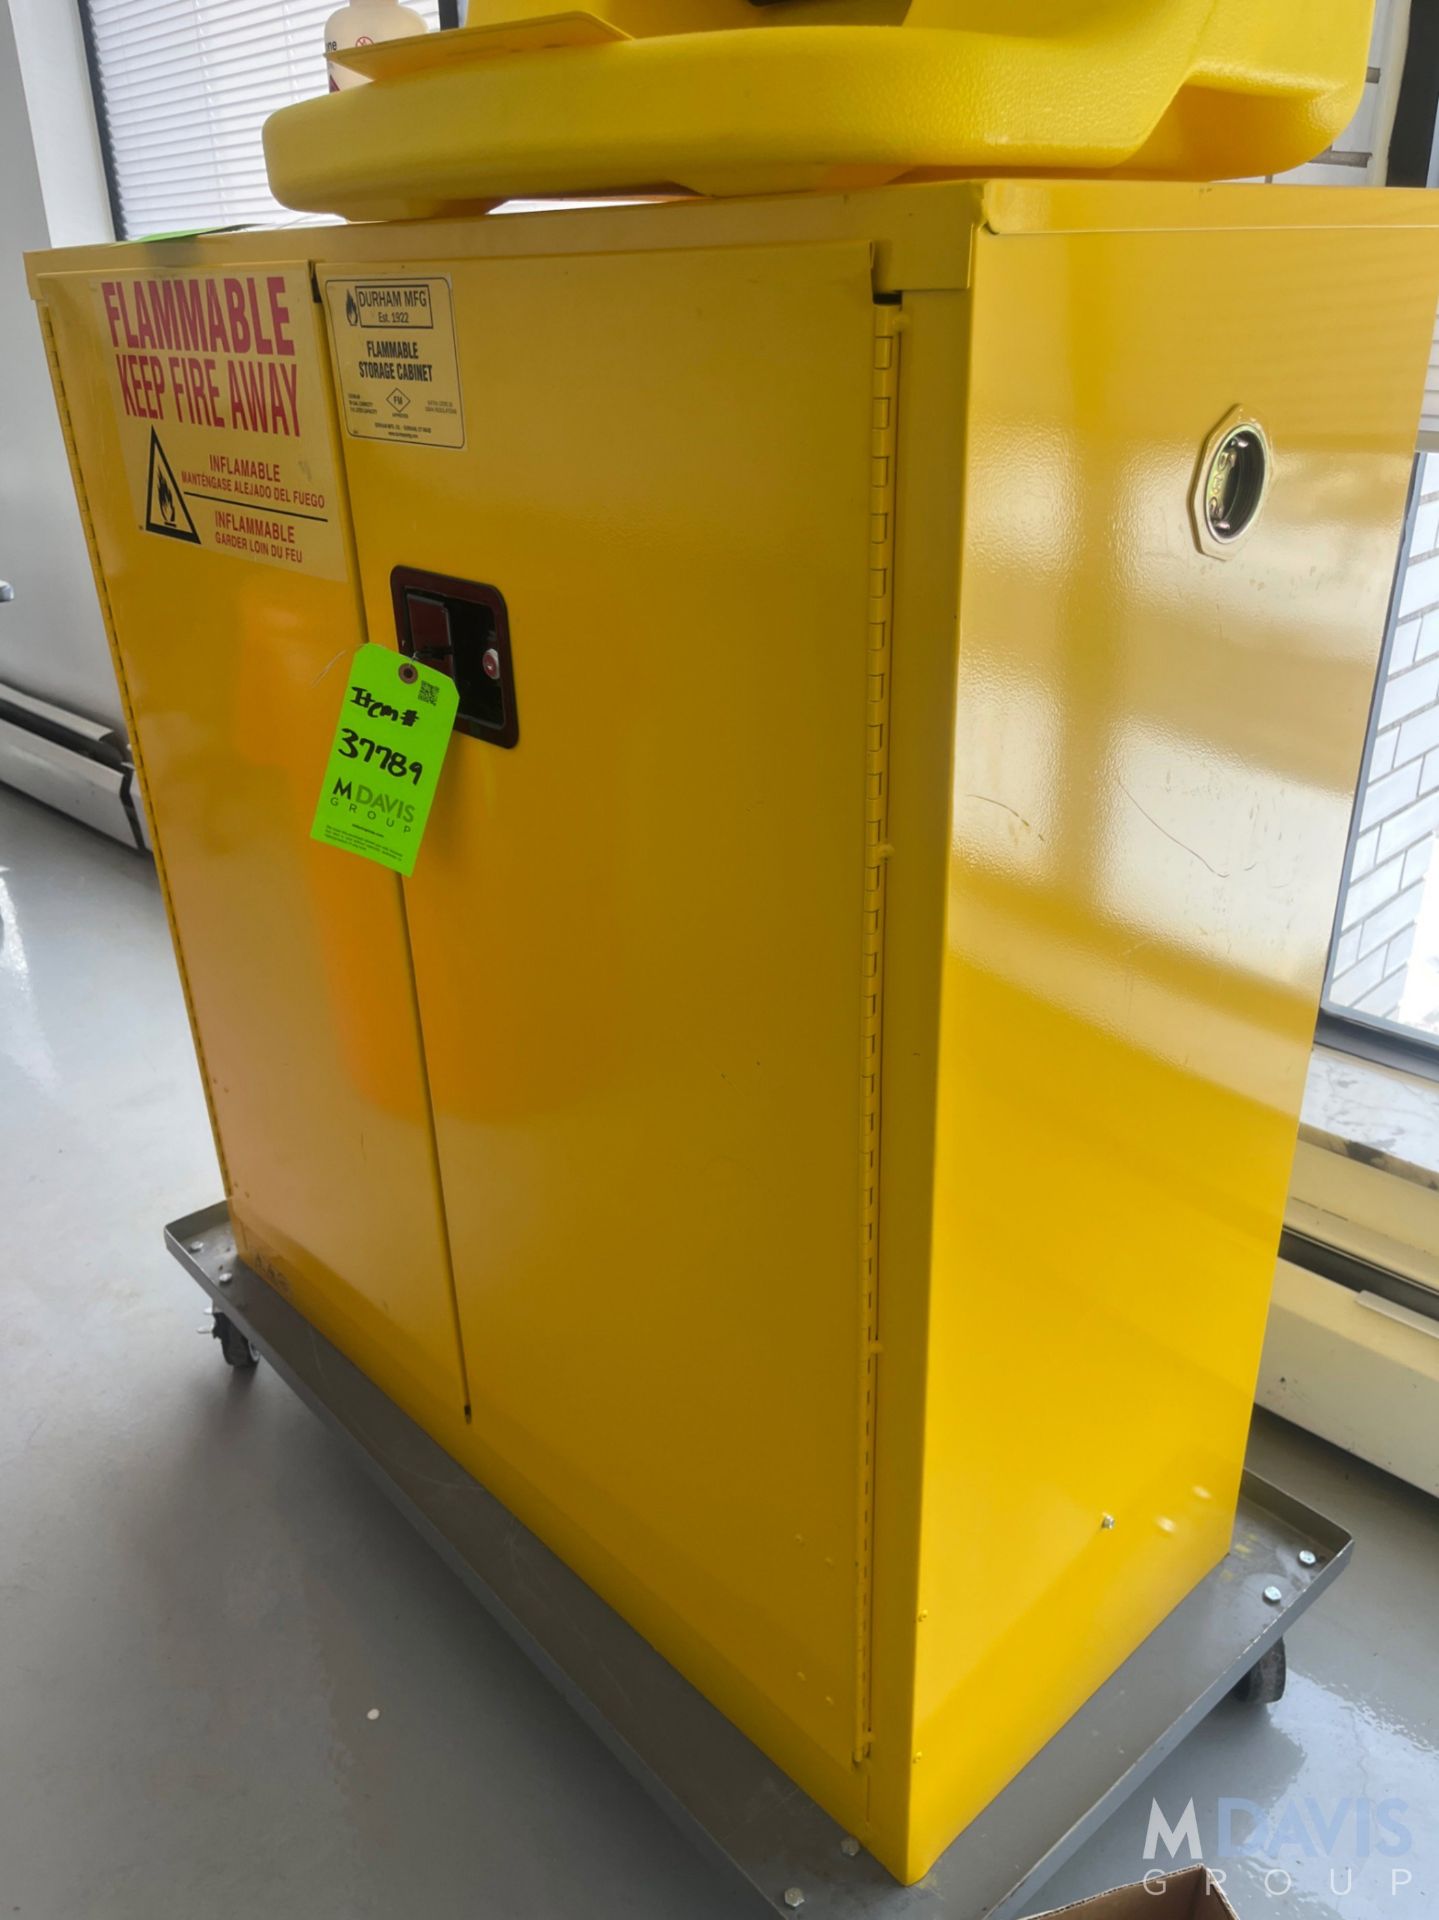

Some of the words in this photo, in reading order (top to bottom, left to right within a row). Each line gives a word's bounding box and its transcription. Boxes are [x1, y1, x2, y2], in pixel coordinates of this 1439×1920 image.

[358, 291, 403, 307] DURHAM
[404, 291, 427, 307] MFG
[101, 276, 296, 356] FLAMMABLE
[391, 312, 409, 323] 1922
[366, 341, 419, 359] FLAMMABLE
[358, 361, 396, 380] STORAGE
[396, 363, 432, 382] CABINET
[116, 354, 165, 420] KEEP
[168, 357, 225, 428] FIRE
[227, 360, 300, 437] AWAY
[209, 454, 281, 482] INFLAMABLE
[234, 481, 271, 499] ALEJADO
[274, 487, 291, 503] DEL
[293, 490, 325, 509] FUEGO
[214, 511, 295, 543] INFLAMMABLE
[215, 531, 248, 550] GARDER
[250, 540, 269, 556] LOIN
[271, 545, 283, 559] DU
[285, 548, 302, 563] FEU
[338, 727, 423, 786] 37789
[330, 796, 411, 834] GROUP
[356, 784, 415, 823] DAVIS
